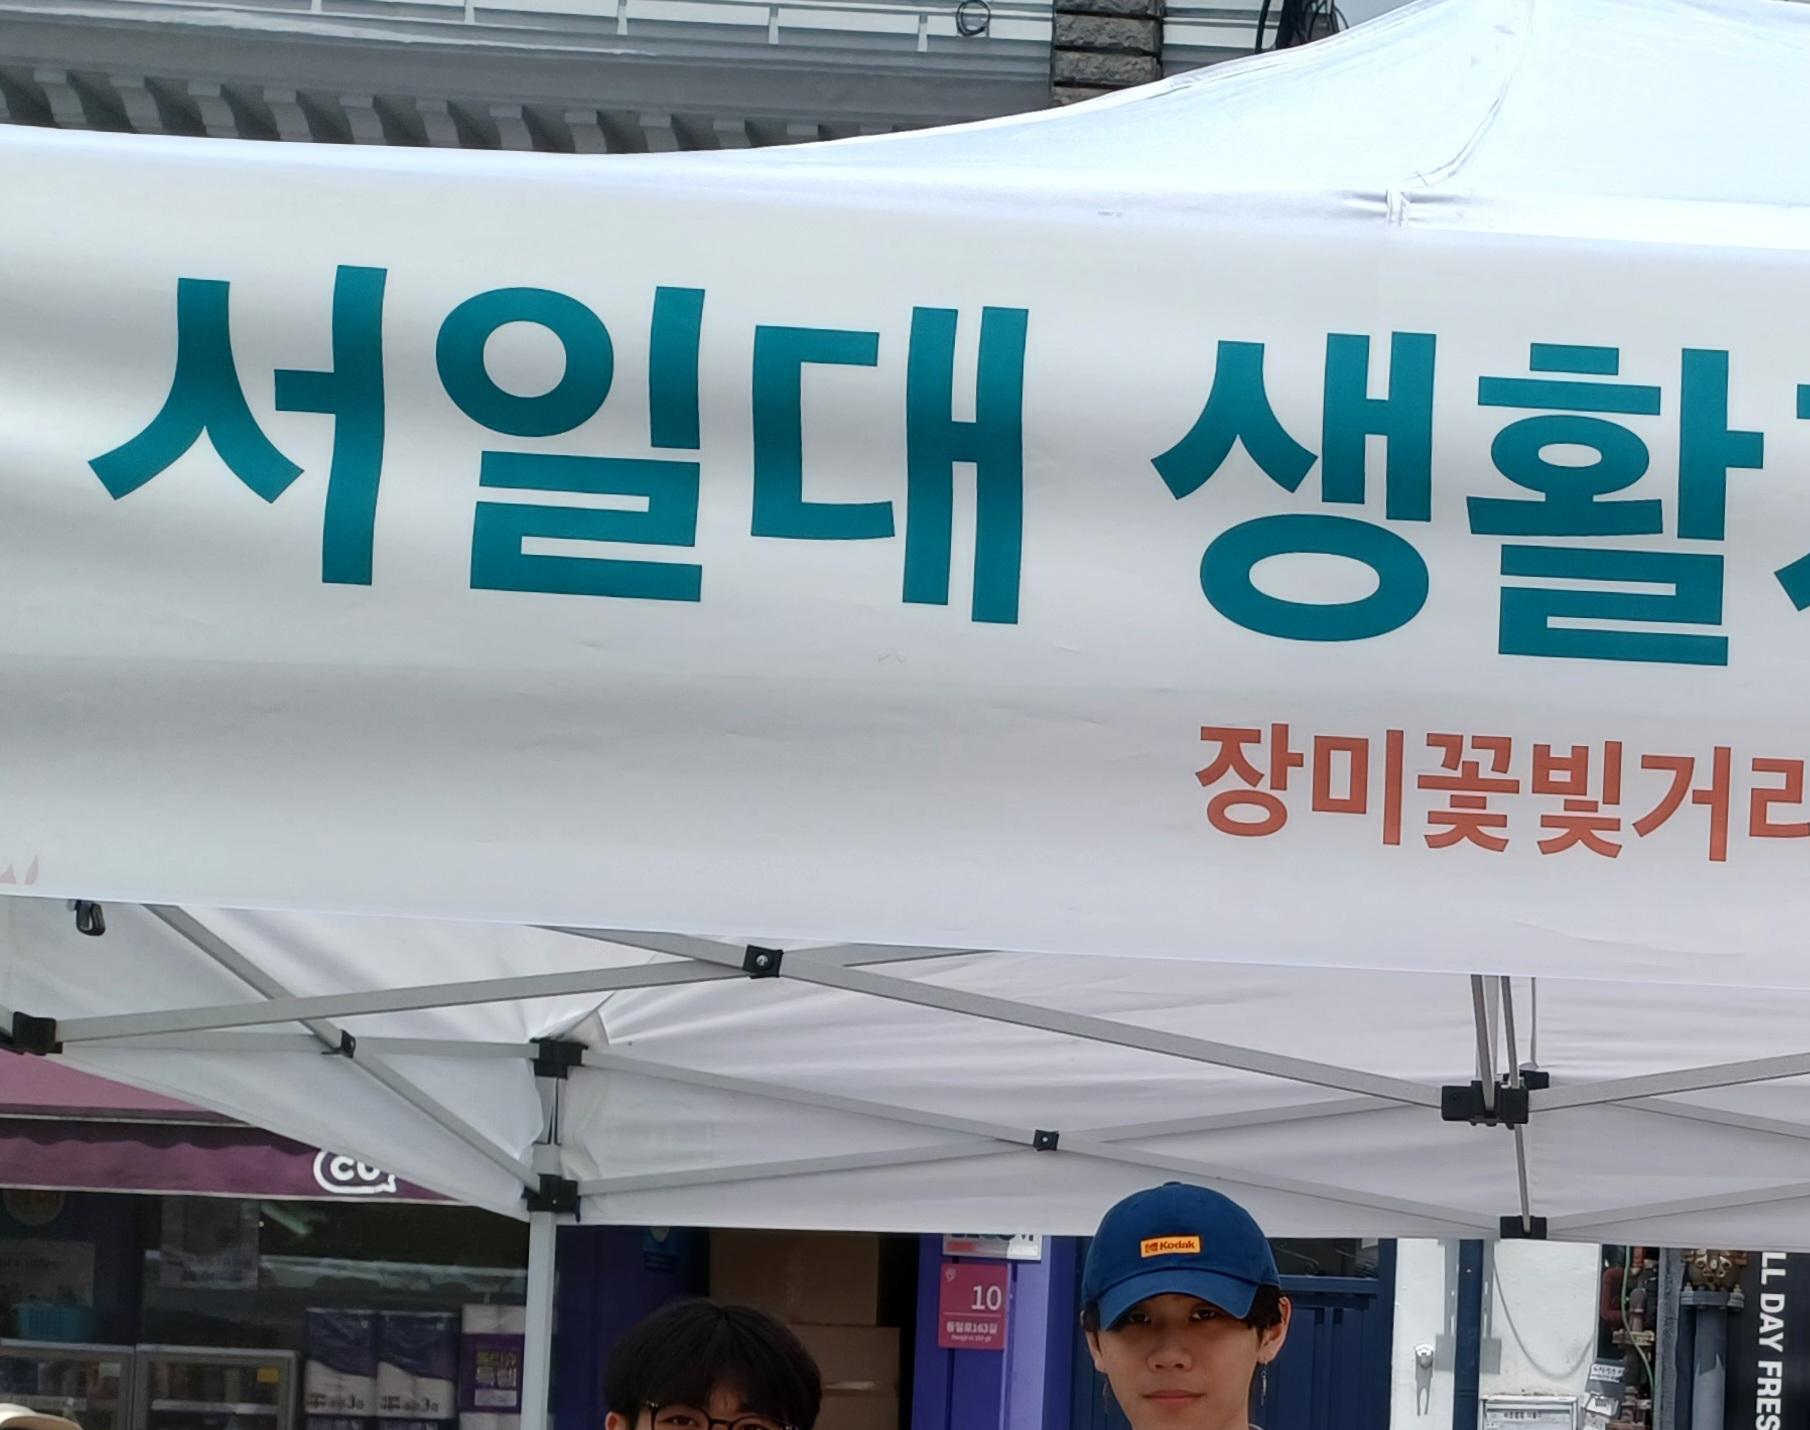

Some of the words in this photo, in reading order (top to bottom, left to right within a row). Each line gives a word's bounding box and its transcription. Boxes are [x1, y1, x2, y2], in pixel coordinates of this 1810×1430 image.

[88, 264, 1028, 624] 서일대
[1160, 1240, 1195, 1250] Kodak
[1761, 1252, 1787, 1285] LL
[971, 1285, 1002, 1311] 10
[1759, 1293, 1785, 1352] DAY
